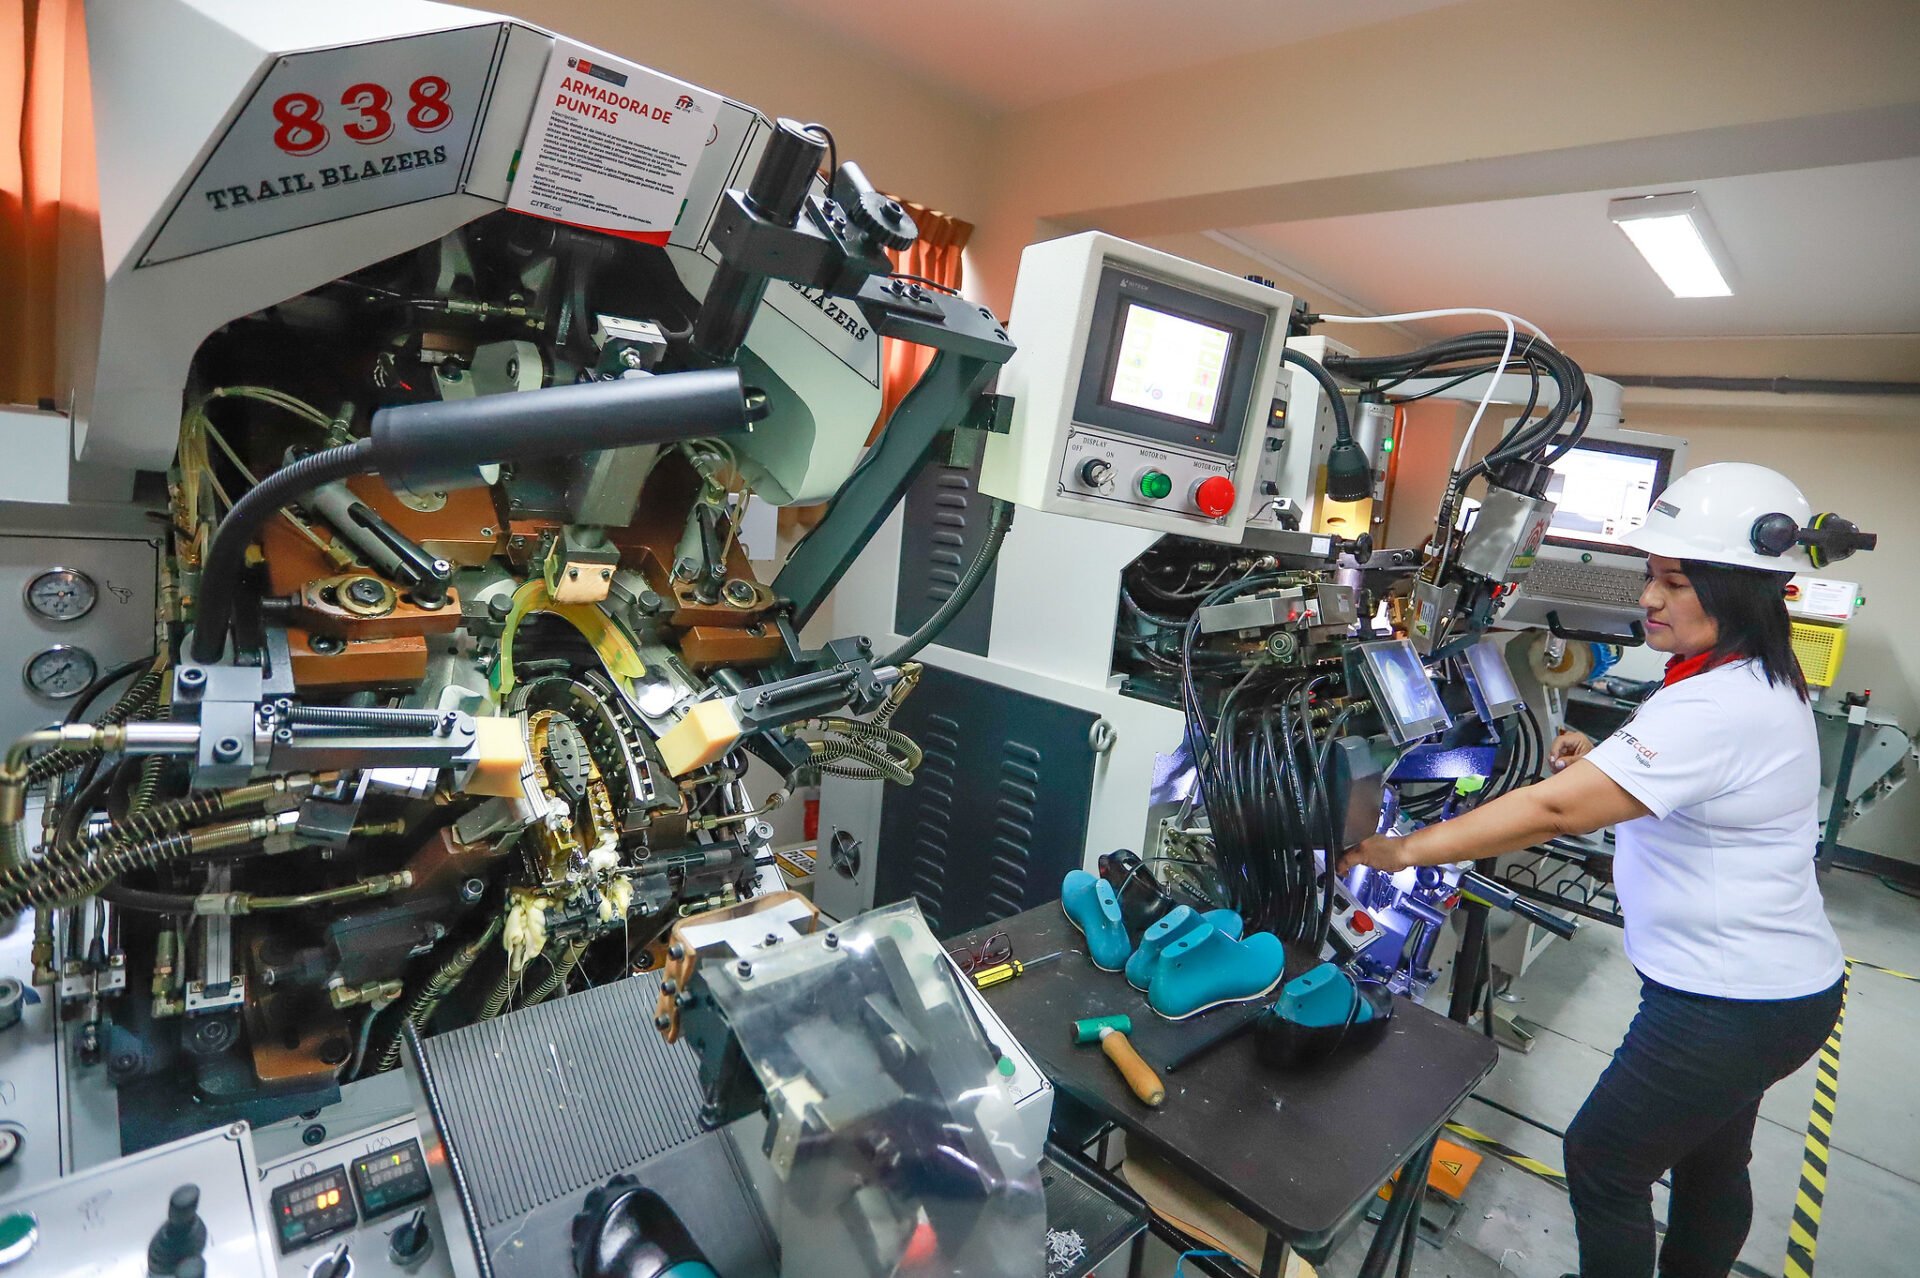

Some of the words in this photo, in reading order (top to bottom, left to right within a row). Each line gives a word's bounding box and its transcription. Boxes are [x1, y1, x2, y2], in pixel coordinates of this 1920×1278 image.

[560, 75, 651, 117] ARMADORA
[651, 107, 673, 125] DE
[555, 93, 619, 125] PUNTAS
[273, 75, 454, 157] 838
[206, 173, 314, 211] TRAIL
[319, 145, 448, 188] BLAZERS
[1072, 444, 1083, 452] OFF
[1083, 437, 1107, 448] DISPLAY
[1106, 451, 1114, 459] ON
[1140, 449, 1158, 459] MOTOR
[1193, 461, 1211, 471] MOTOR
[1211, 465, 1222, 473] OFF
